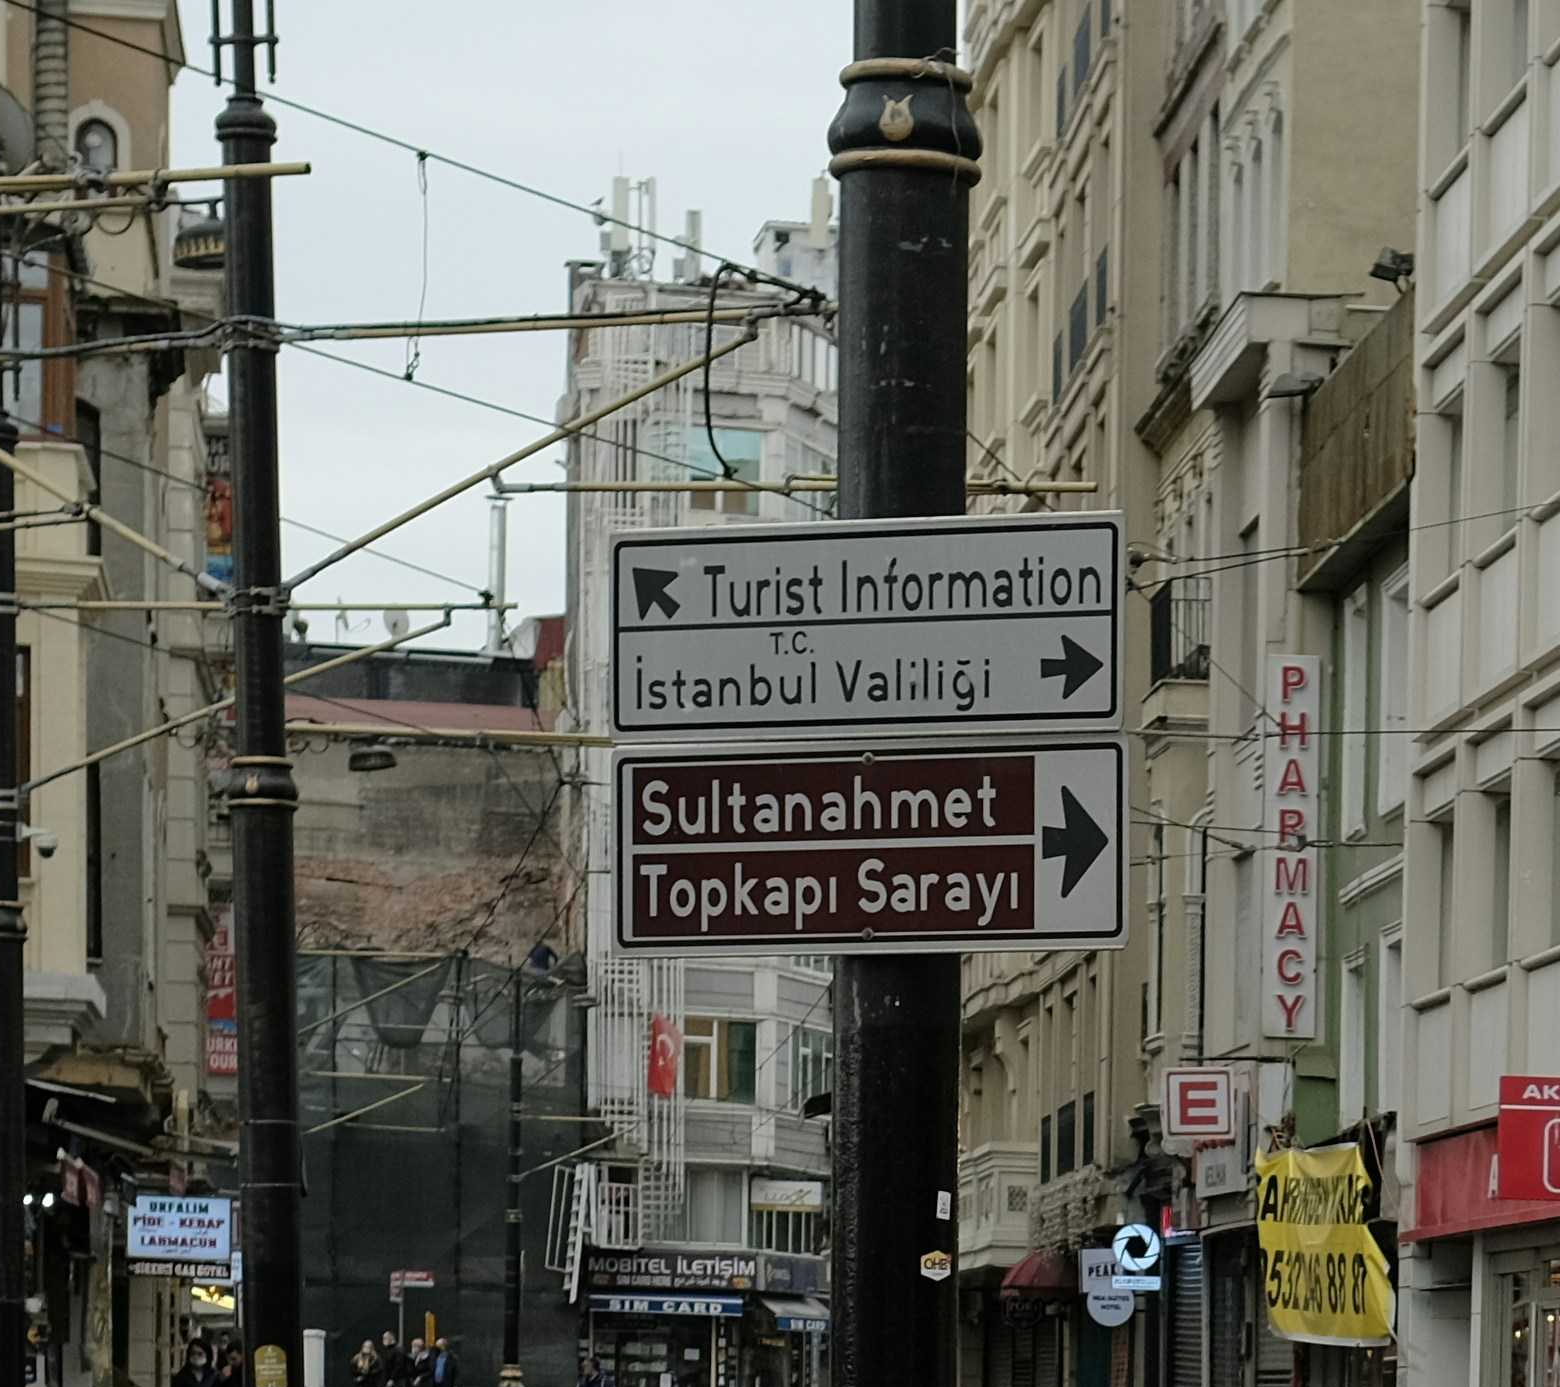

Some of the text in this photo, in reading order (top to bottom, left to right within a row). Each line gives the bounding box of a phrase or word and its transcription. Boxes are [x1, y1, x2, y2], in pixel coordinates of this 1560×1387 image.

[703, 556, 1102, 617] Turist Information
[769, 630, 816, 656] T.C.
[635, 655, 992, 712] İstanbul Valiliği
[641, 775, 998, 836] Sultanahmet
[1273, 664, 1310, 1034] PHARMACY
[640, 858, 1020, 932] Topkapı Sarayı
[1178, 1080, 1219, 1126] E
[587, 1254, 671, 1275] MOBİTEL
[676, 1255, 756, 1278] İLETİŞİM
[608, 1299, 723, 1315] SIM CARD
